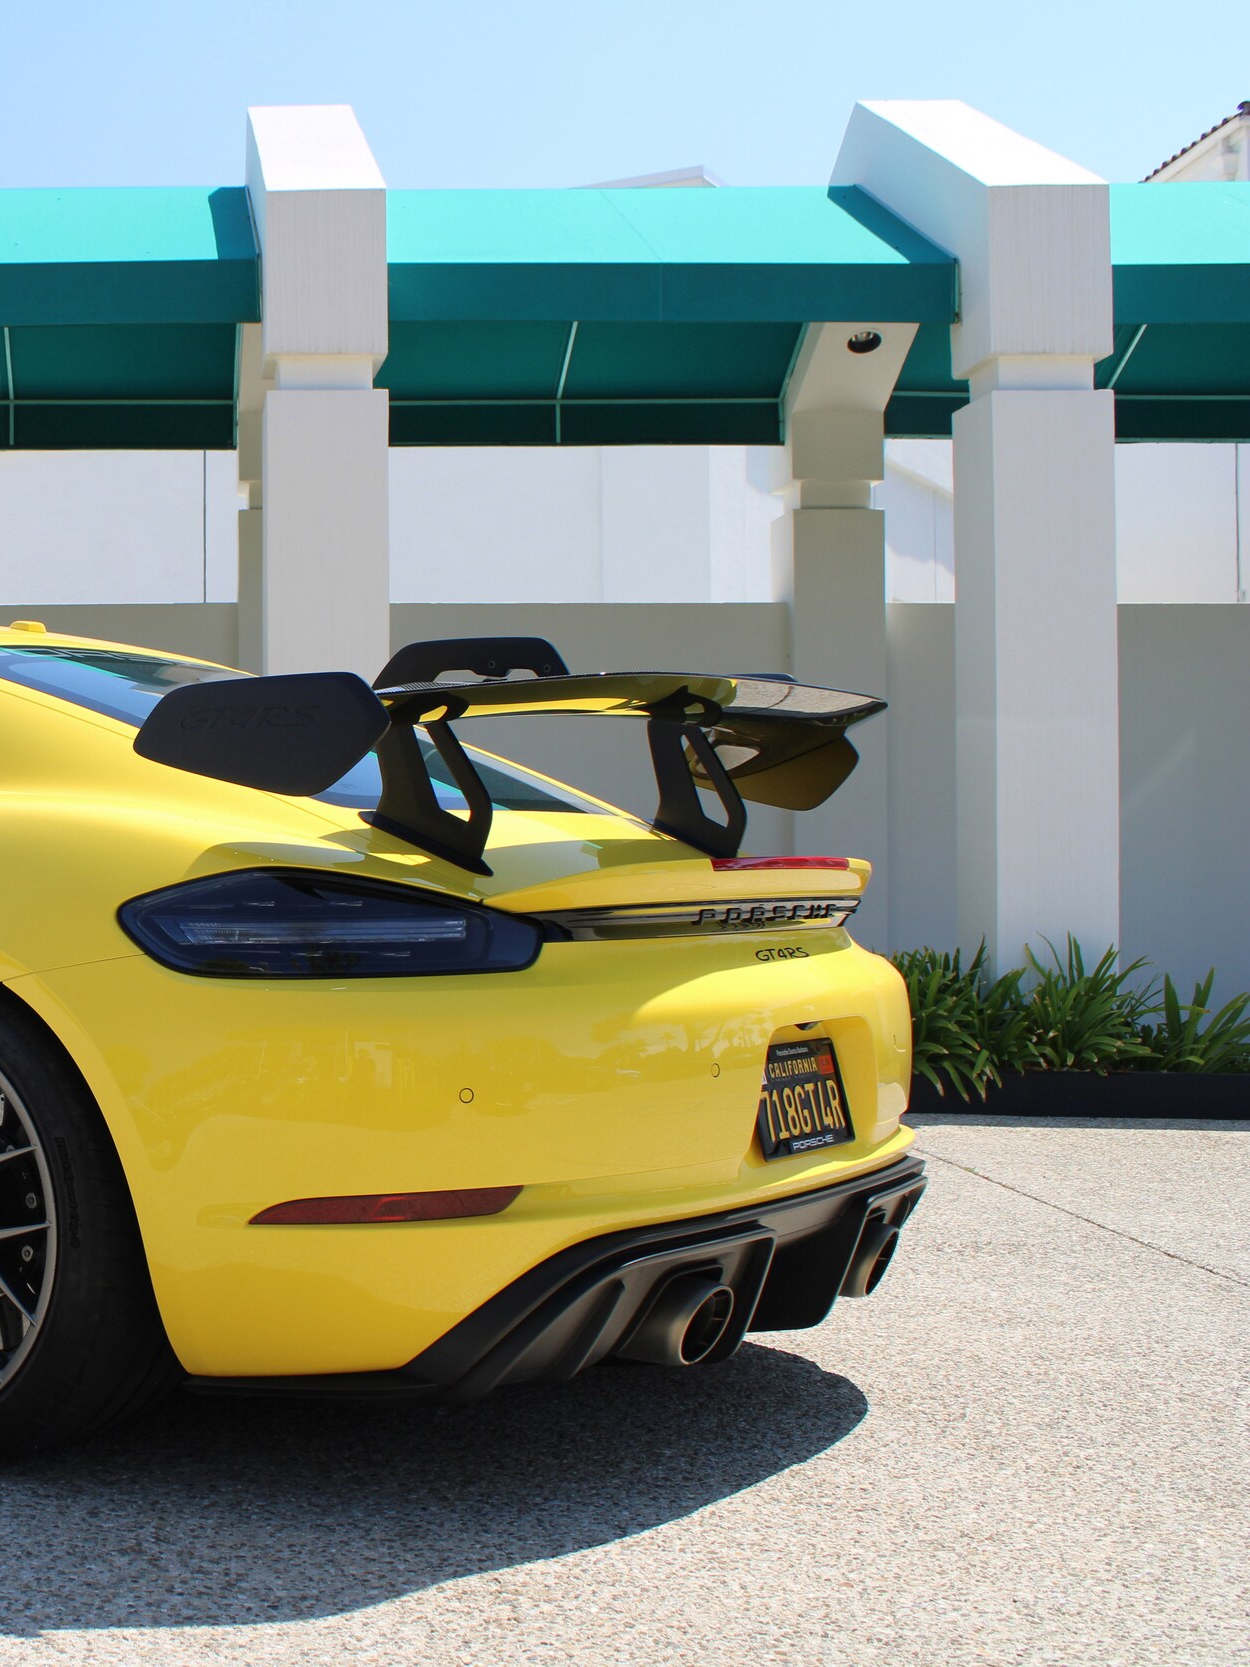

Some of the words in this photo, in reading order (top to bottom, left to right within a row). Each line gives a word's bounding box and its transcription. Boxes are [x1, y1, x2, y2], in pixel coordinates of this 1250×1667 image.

[692, 903, 837, 925] PORSCHE
[755, 947, 809, 962] GT4RS
[768, 1056, 818, 1079] CALIFORNIA
[760, 1079, 846, 1143] 718GT4R
[792, 1134, 834, 1151] PORSCHE
